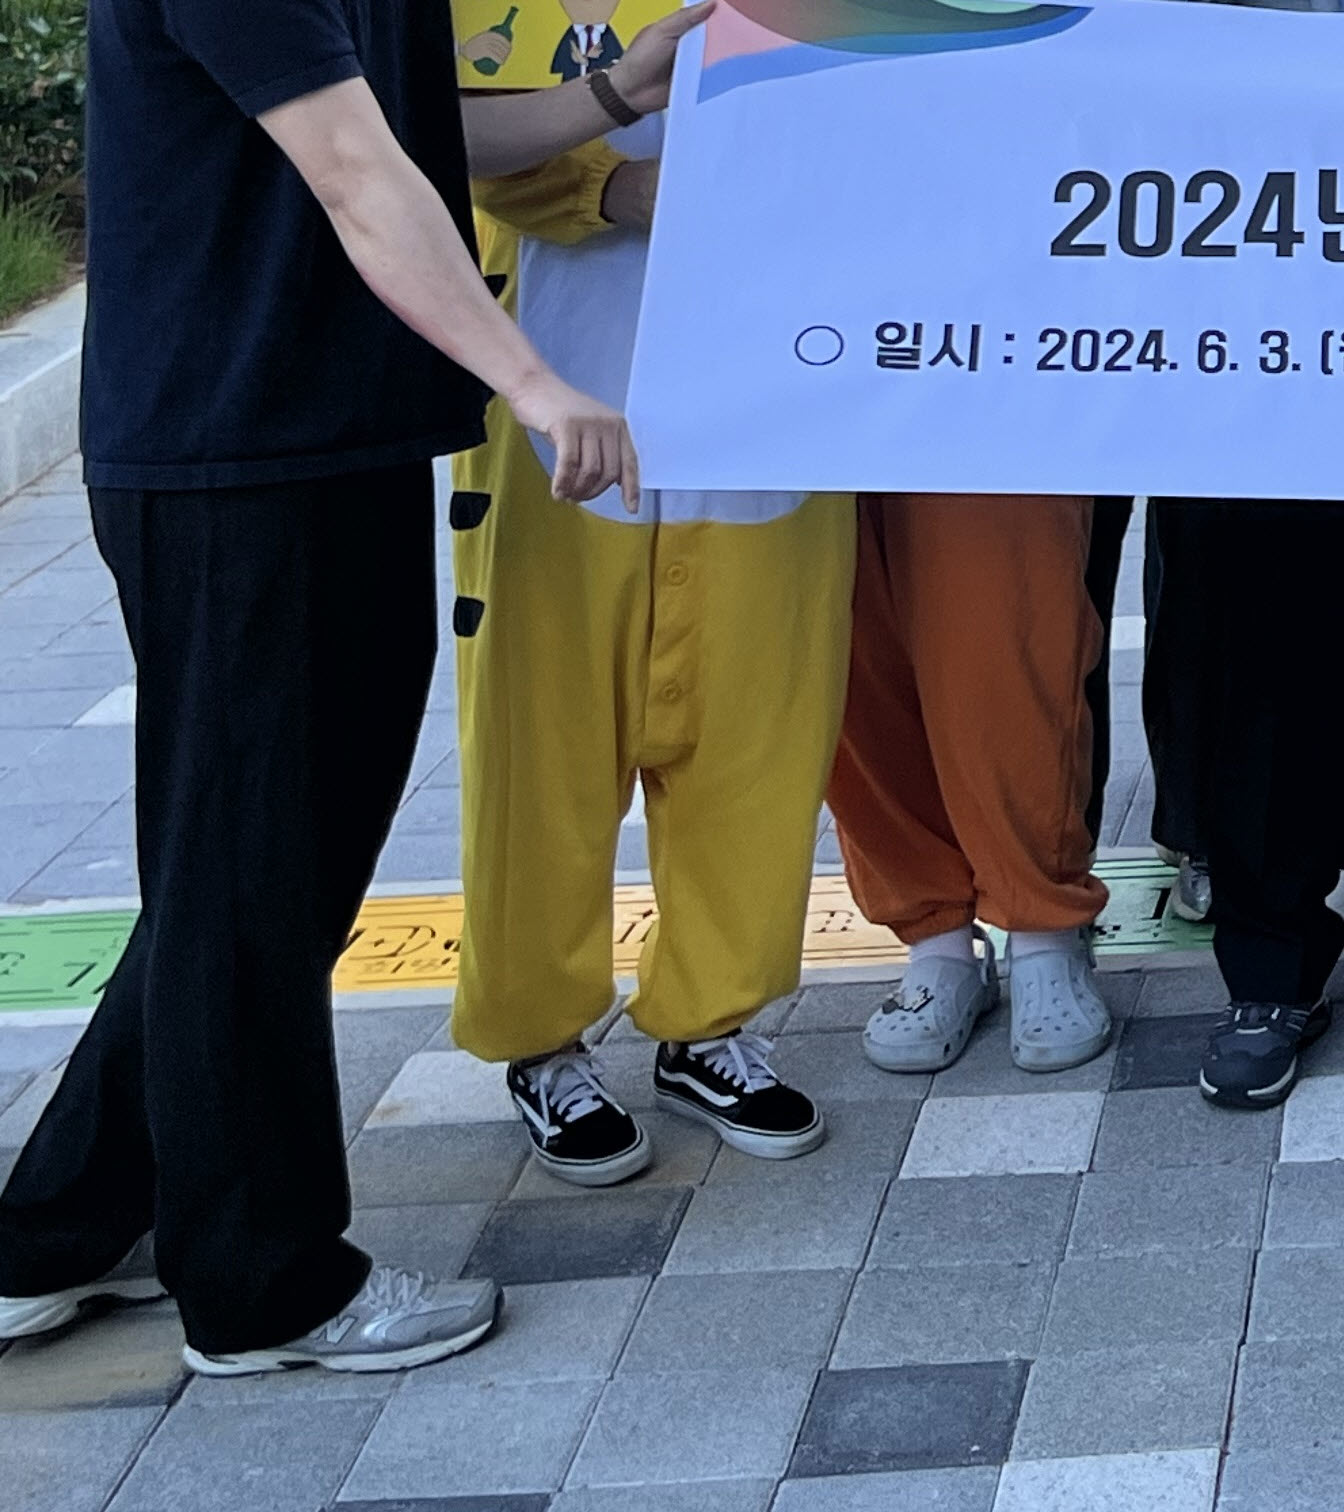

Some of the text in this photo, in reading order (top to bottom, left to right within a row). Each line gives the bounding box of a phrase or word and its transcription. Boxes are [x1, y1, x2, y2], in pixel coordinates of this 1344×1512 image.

[1036, 328, 1178, 373] 2024.
[1197, 329, 1239, 374] 6.
[1259, 329, 1301, 374] 3.
